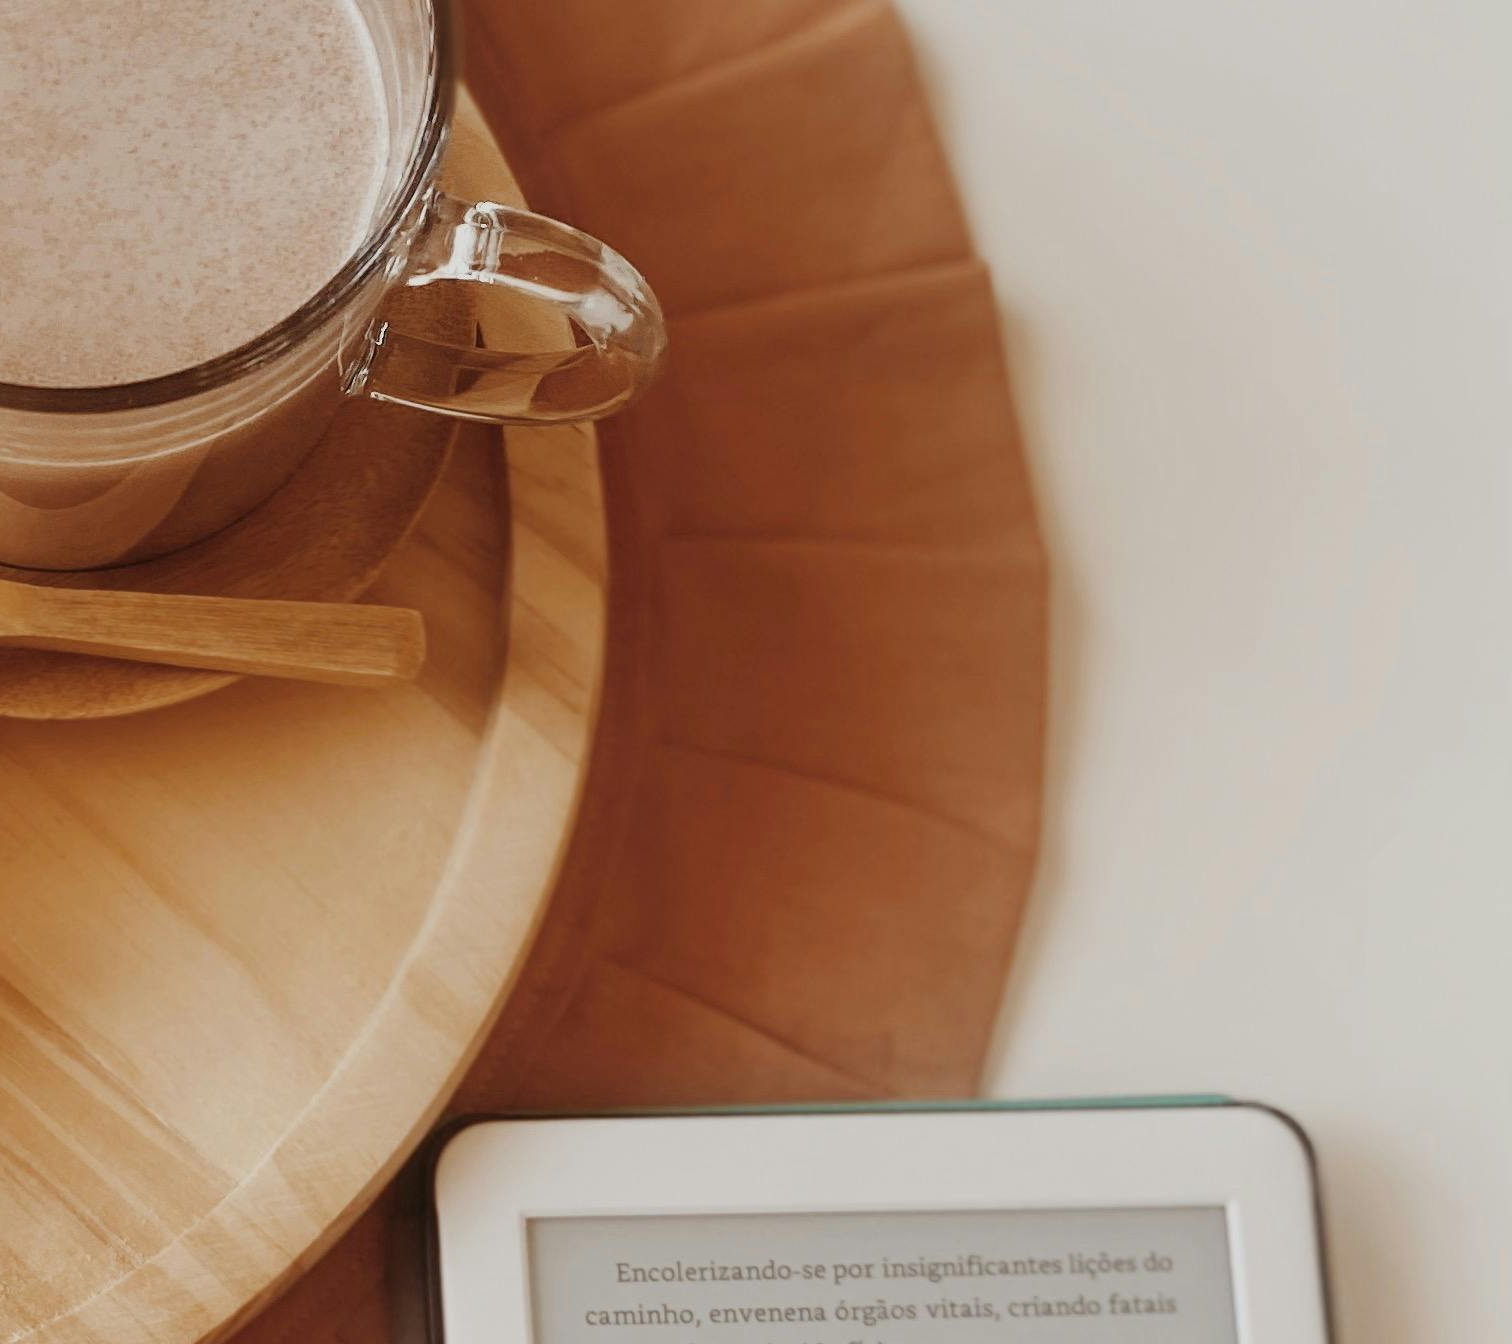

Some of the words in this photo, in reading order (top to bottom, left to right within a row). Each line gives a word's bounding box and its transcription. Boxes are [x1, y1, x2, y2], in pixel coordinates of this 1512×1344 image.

[615, 1258, 827, 1284] Encolerizando-se
[831, 1263, 875, 1286] por
[881, 1254, 1064, 1284] insignificantes
[1143, 1251, 1174, 1273] do
[584, 1303, 702, 1329] caminho,
[708, 1306, 828, 1324] envenena
[834, 1298, 918, 1327] órgãos
[925, 1296, 1001, 1322] vitais,
[1007, 1294, 1103, 1318] criando
[1108, 1292, 1177, 1316] fatais
